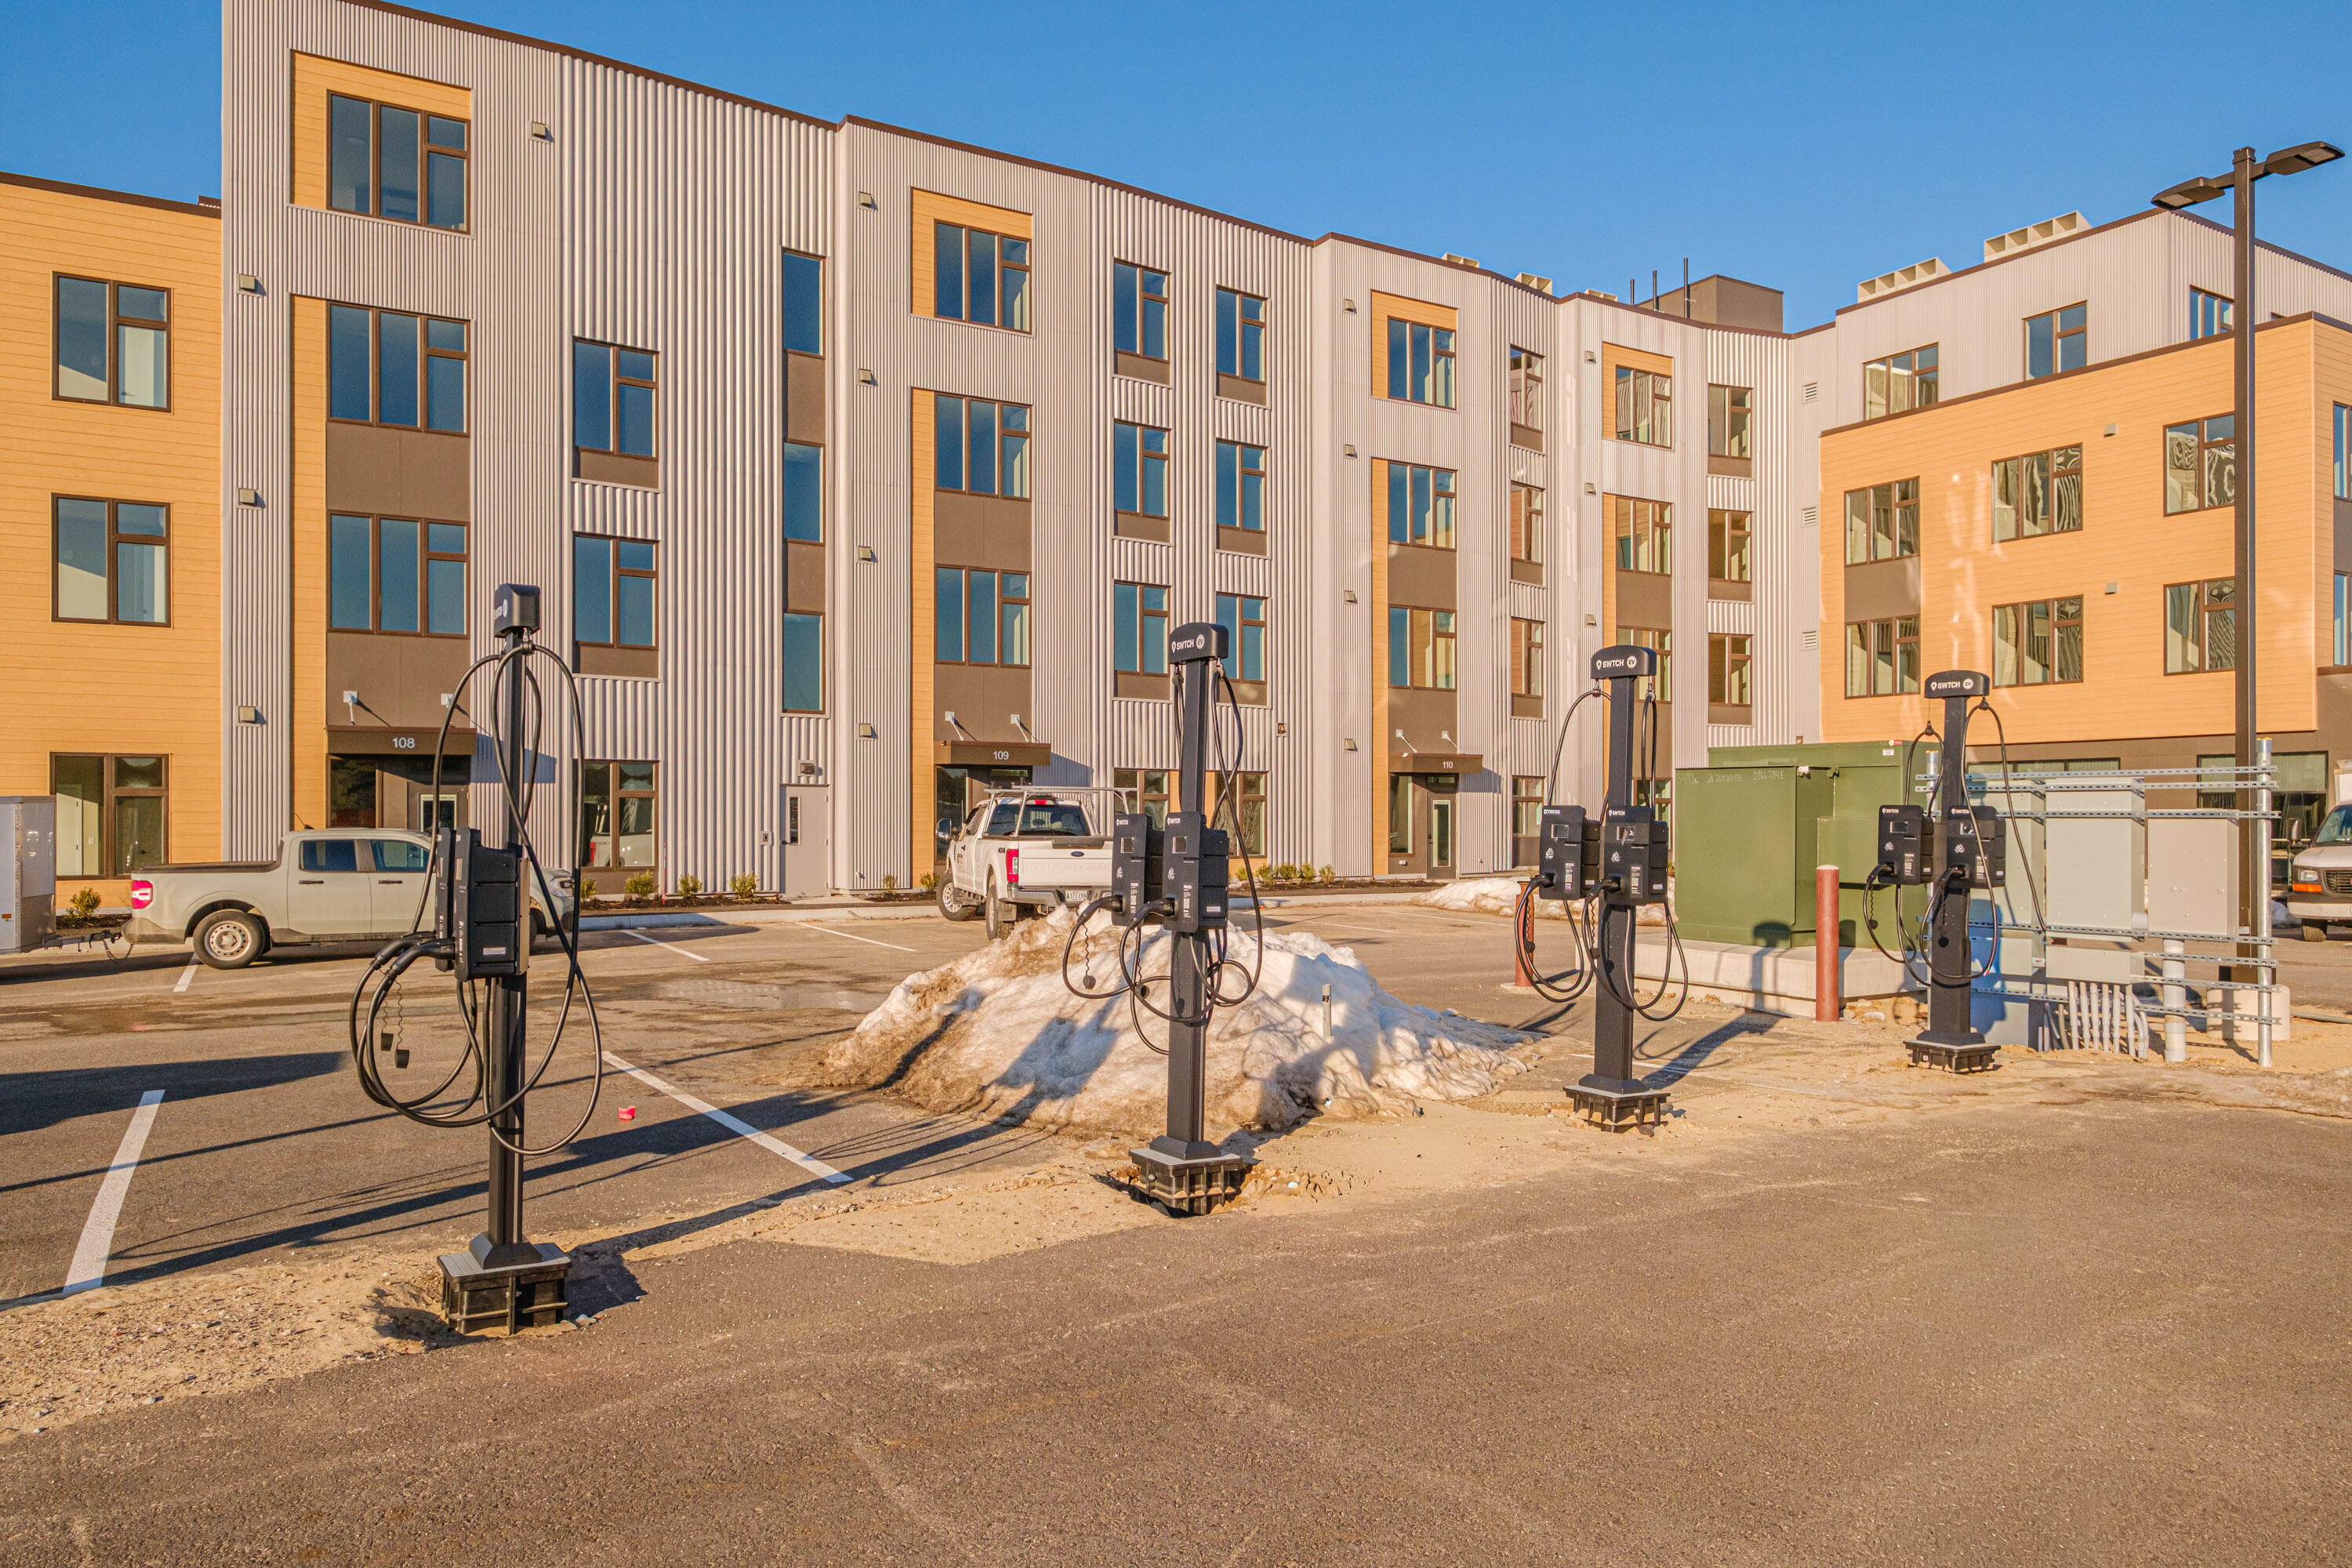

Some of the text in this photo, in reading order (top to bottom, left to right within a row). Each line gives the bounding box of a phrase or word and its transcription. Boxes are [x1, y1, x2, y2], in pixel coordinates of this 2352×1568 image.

[1176, 639, 1194, 651] SWTCH
[1602, 659, 1624, 668] SWTCH
[392, 737, 415, 749] 108
[993, 750, 1009, 760] 109
[1443, 760, 1453, 769] 110
